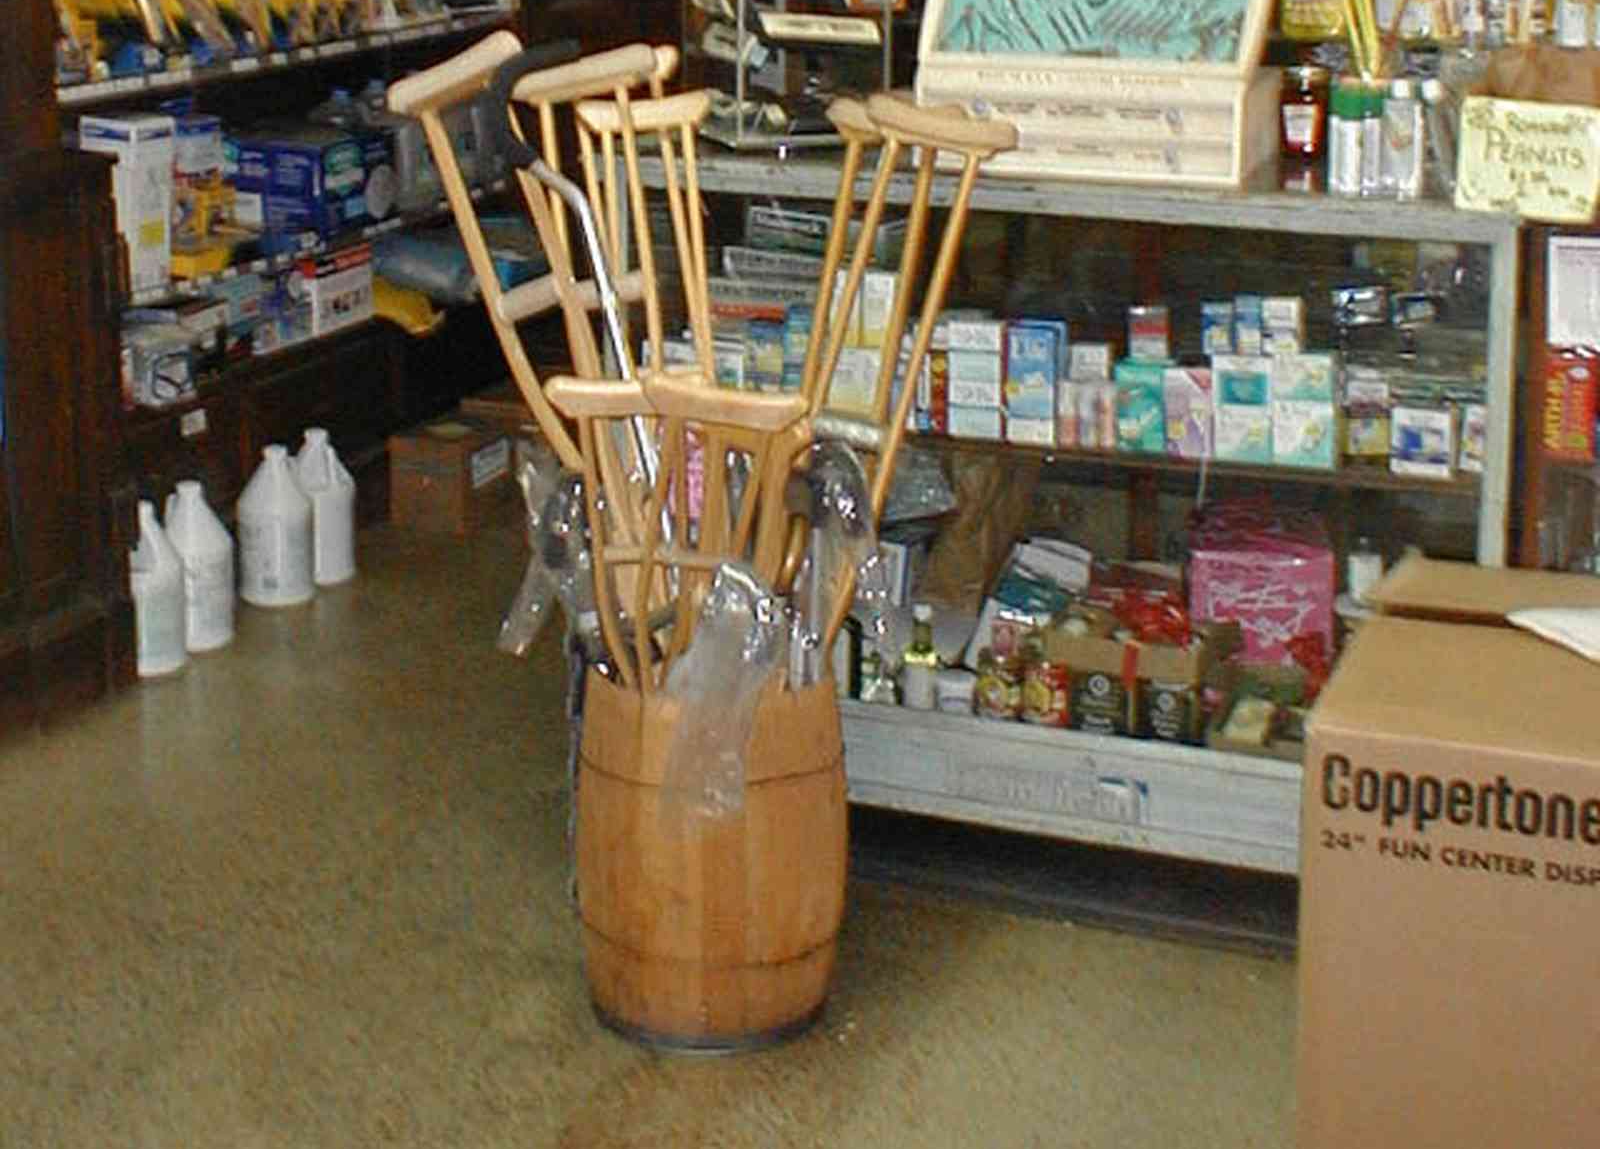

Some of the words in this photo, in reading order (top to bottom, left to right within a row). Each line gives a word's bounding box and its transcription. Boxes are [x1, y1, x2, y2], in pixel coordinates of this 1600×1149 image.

[1322, 753, 1600, 846] Coppertone
[1379, 837, 1431, 862] FUN
[1442, 847, 1536, 878] CENTER
